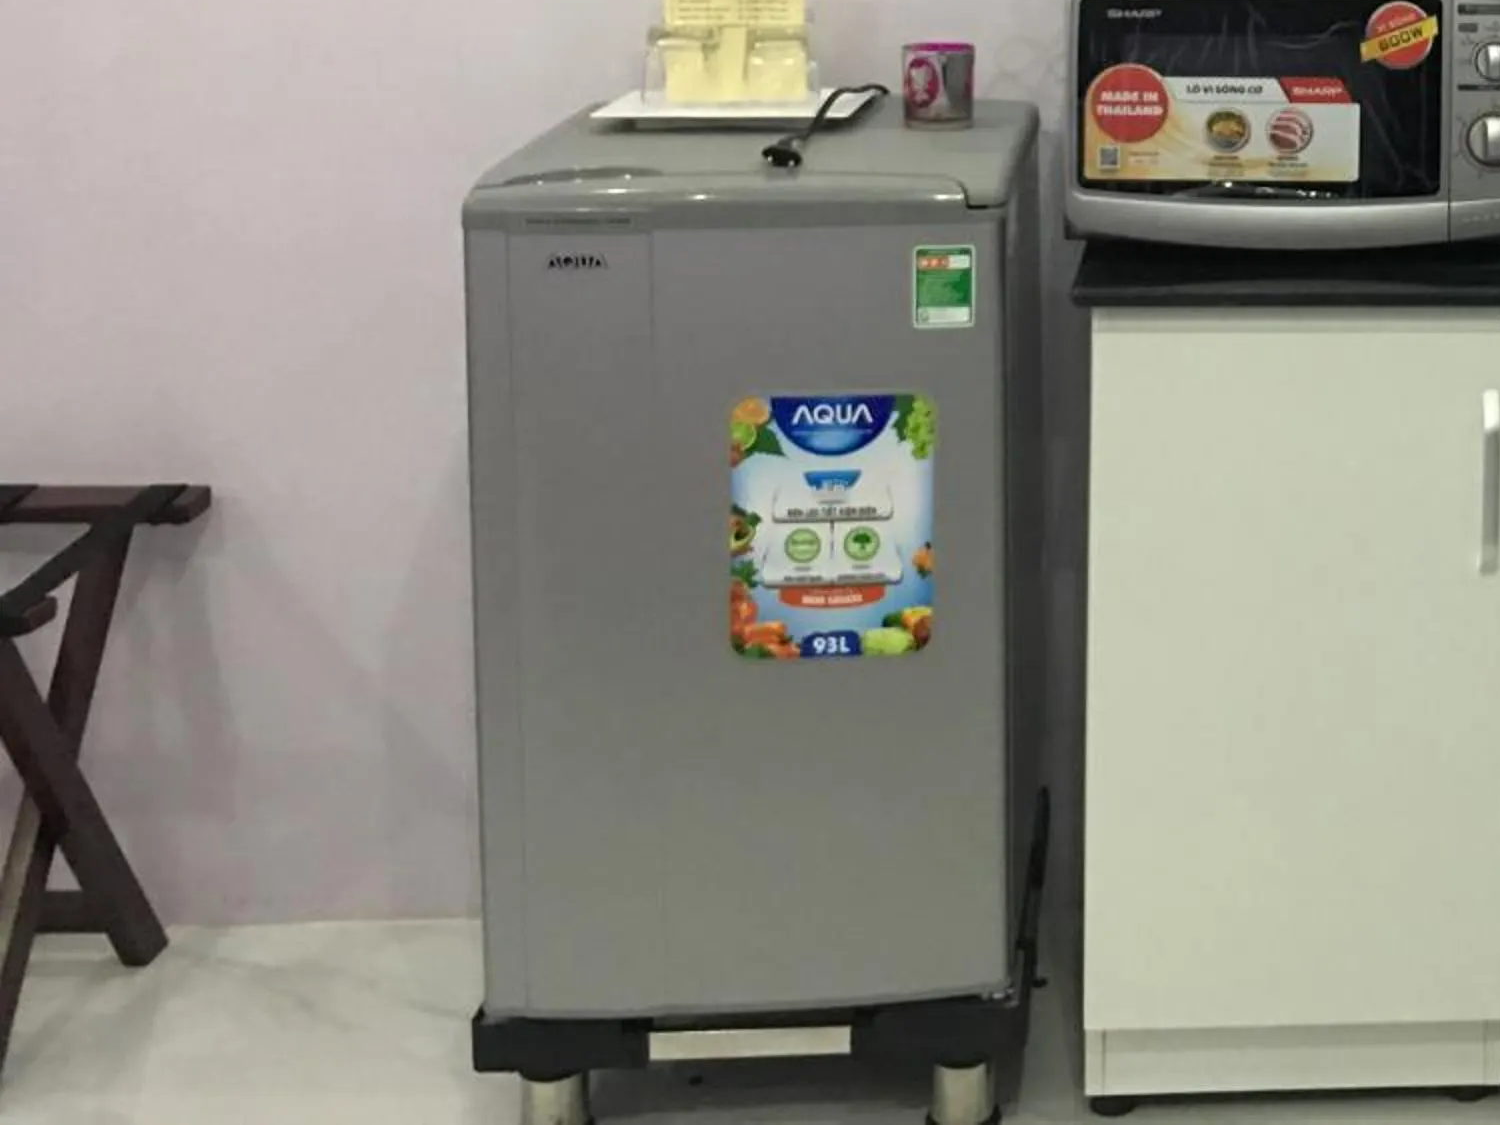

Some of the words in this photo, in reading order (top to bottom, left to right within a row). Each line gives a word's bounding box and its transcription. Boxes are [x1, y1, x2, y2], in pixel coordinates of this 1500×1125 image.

[1101, 91, 1139, 102] MADE
[1143, 91, 1159, 102] IN
[1096, 104, 1164, 116] THAILAND
[792, 403, 873, 424] AQUA
[813, 637, 850, 654] 93L
